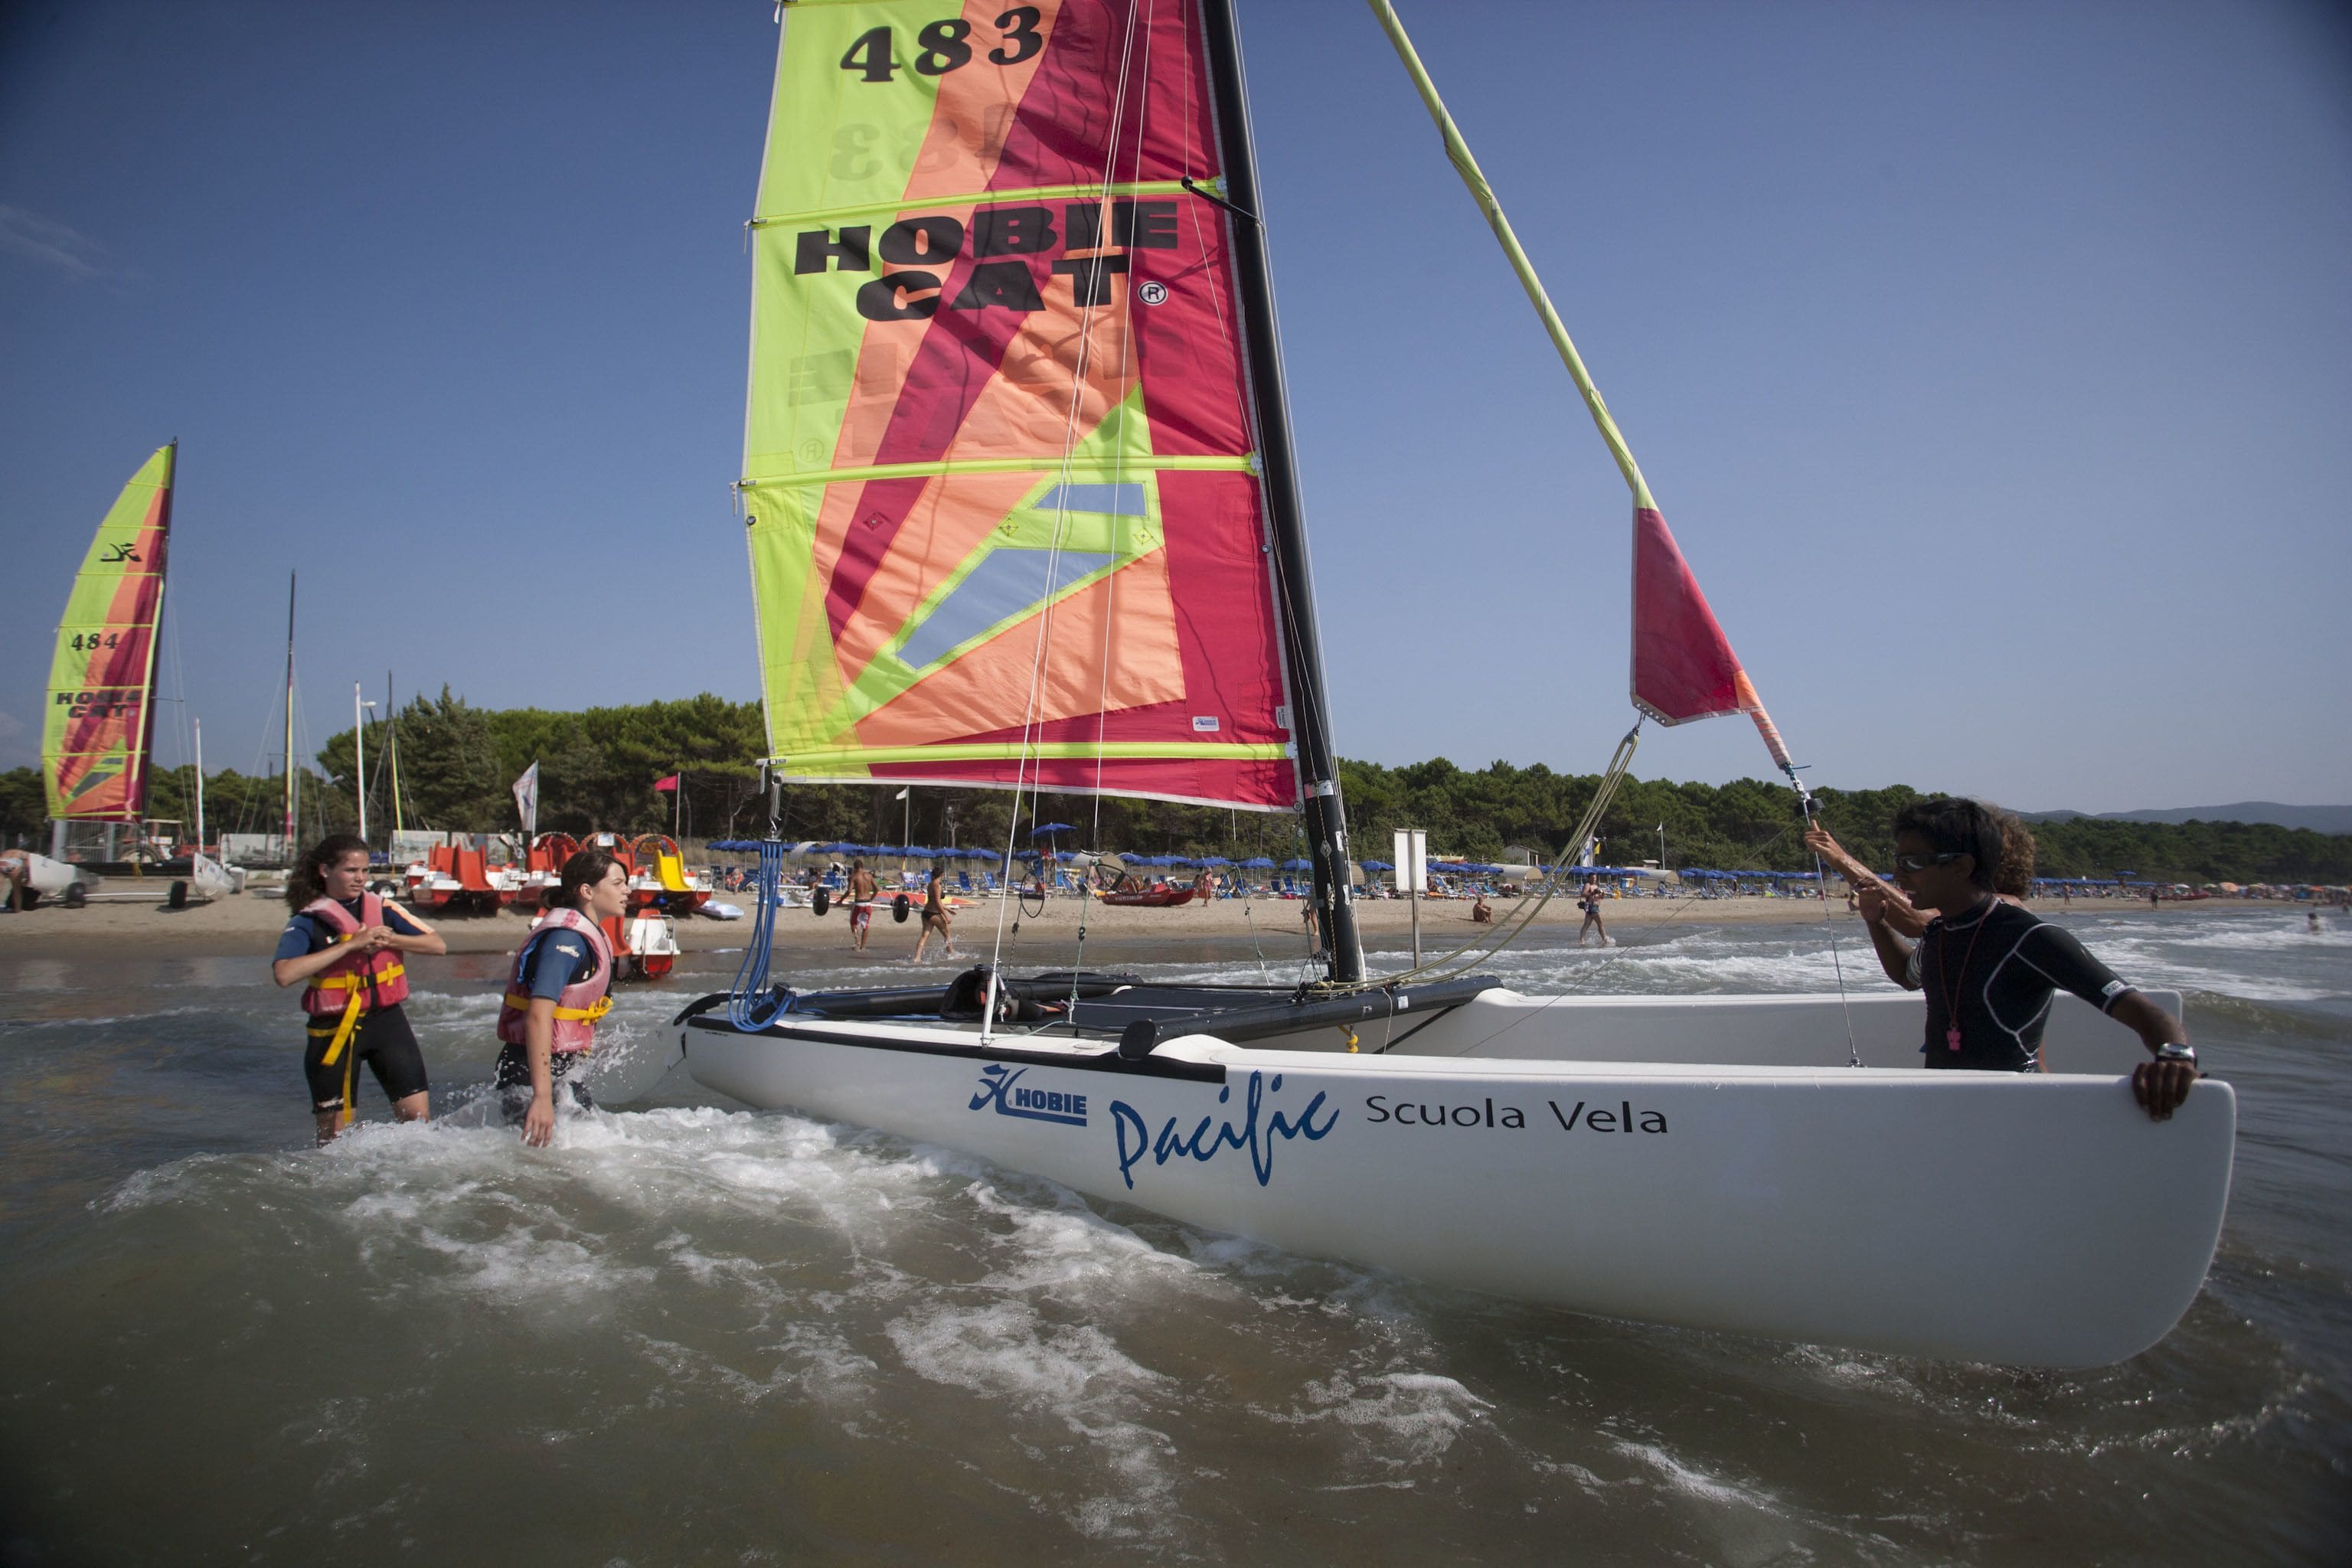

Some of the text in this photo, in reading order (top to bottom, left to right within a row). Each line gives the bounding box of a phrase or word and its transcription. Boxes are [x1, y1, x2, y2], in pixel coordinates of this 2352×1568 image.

[840, 6, 1044, 83] 483
[794, 201, 1178, 275] HOBIE
[856, 254, 1130, 322] CAT
[71, 632, 119, 651] 484
[1016, 1088, 1087, 1116] HOBIE
[1109, 1070, 1340, 1190] Pacific
[1366, 1096, 1668, 1134] Scuola Vela
